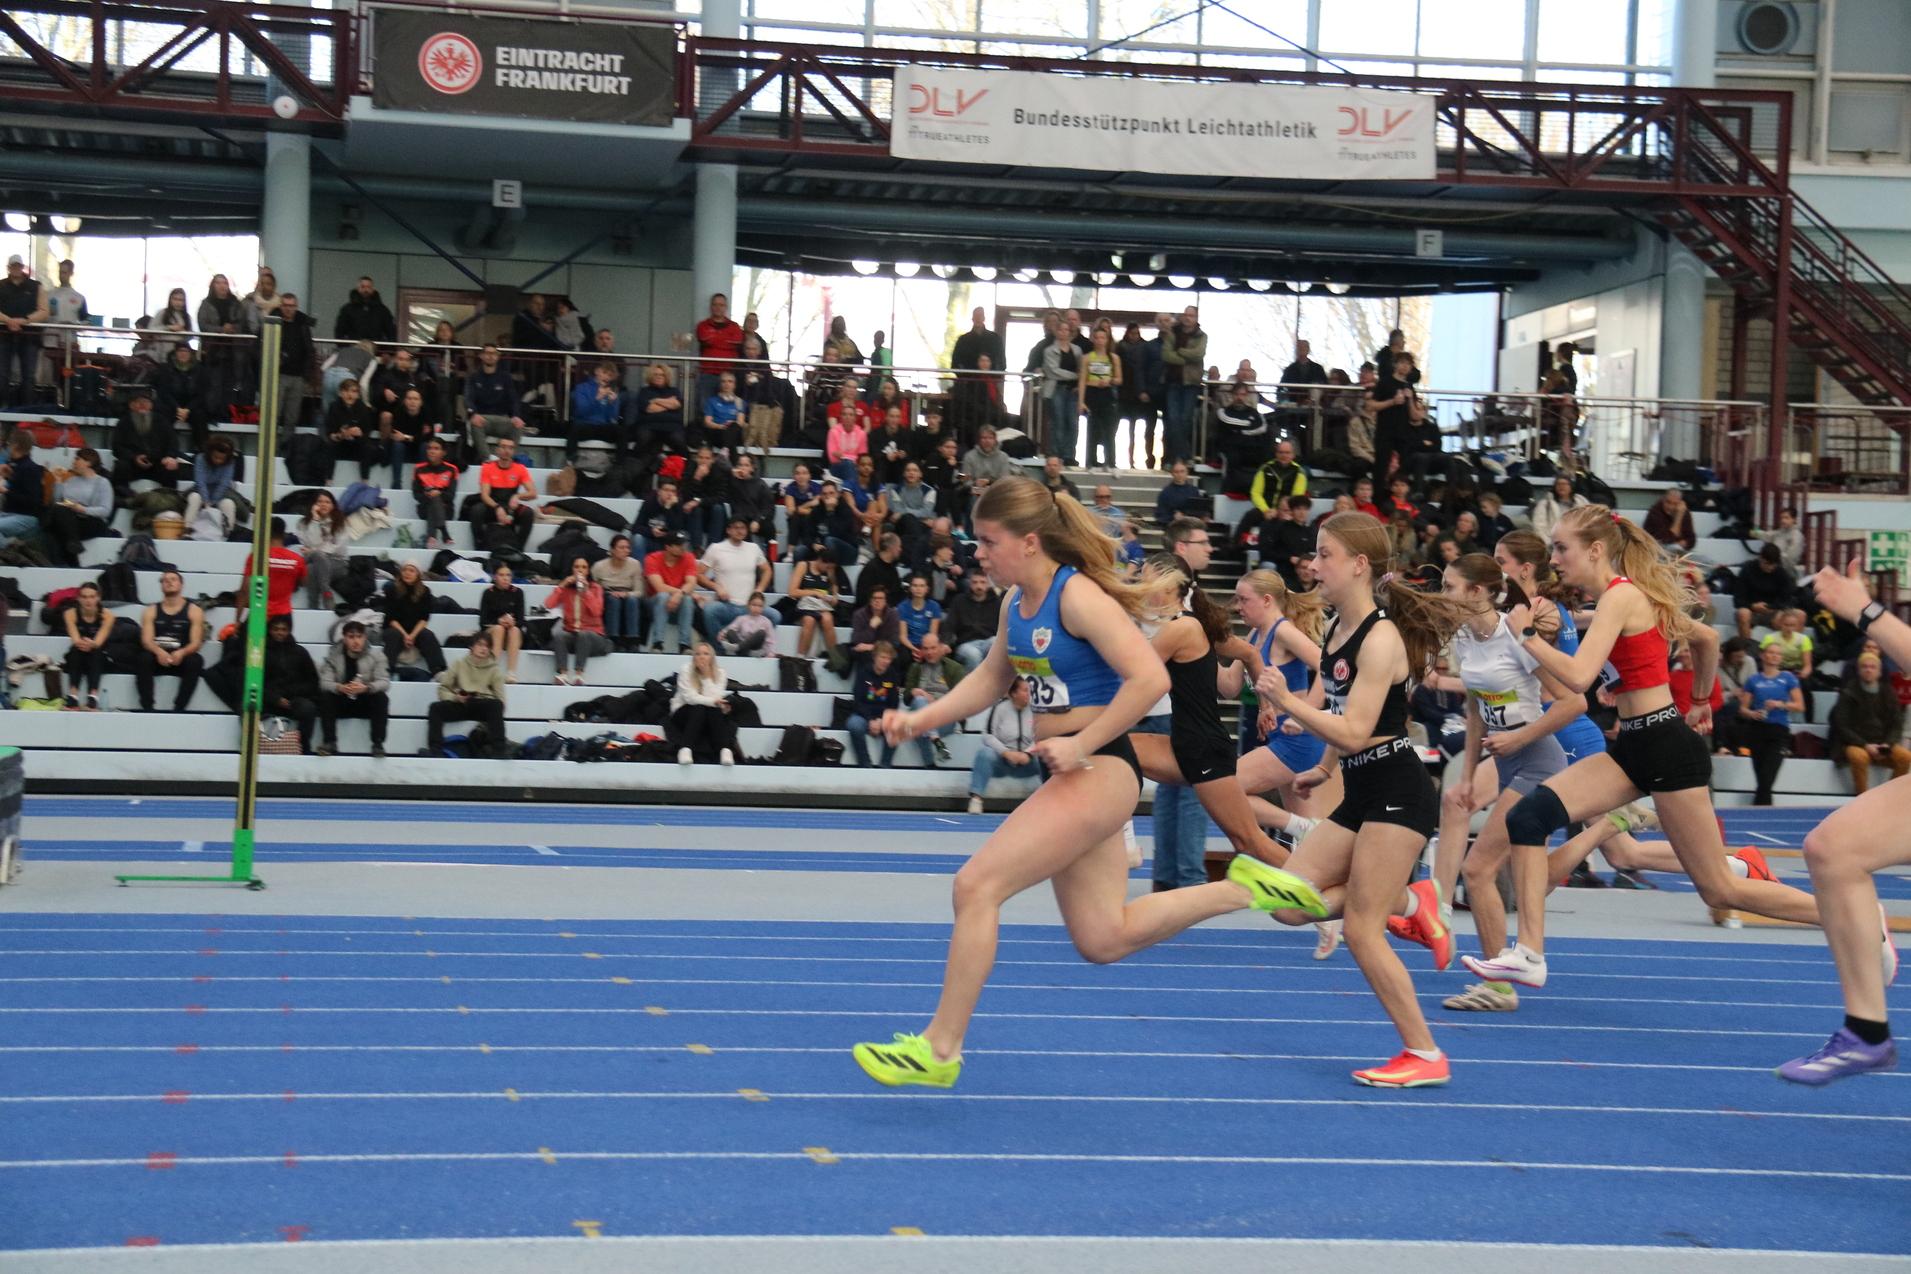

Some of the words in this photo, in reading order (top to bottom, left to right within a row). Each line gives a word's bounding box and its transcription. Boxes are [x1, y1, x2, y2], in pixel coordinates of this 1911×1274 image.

[496, 46, 625, 73] EINTRACHT
[496, 68, 632, 95] FRANKFURT
[908, 83, 990, 117] DLV
[1013, 107, 1181, 135] Bundesstützpunkt
[1187, 117, 1318, 140] Leichtathletik
[1336, 106, 1413, 137] DLV
[500, 184, 515, 203] E
[1423, 234, 1436, 252] F
[1646, 707, 1678, 727] PRO
[1347, 744, 1390, 769] NIKE
